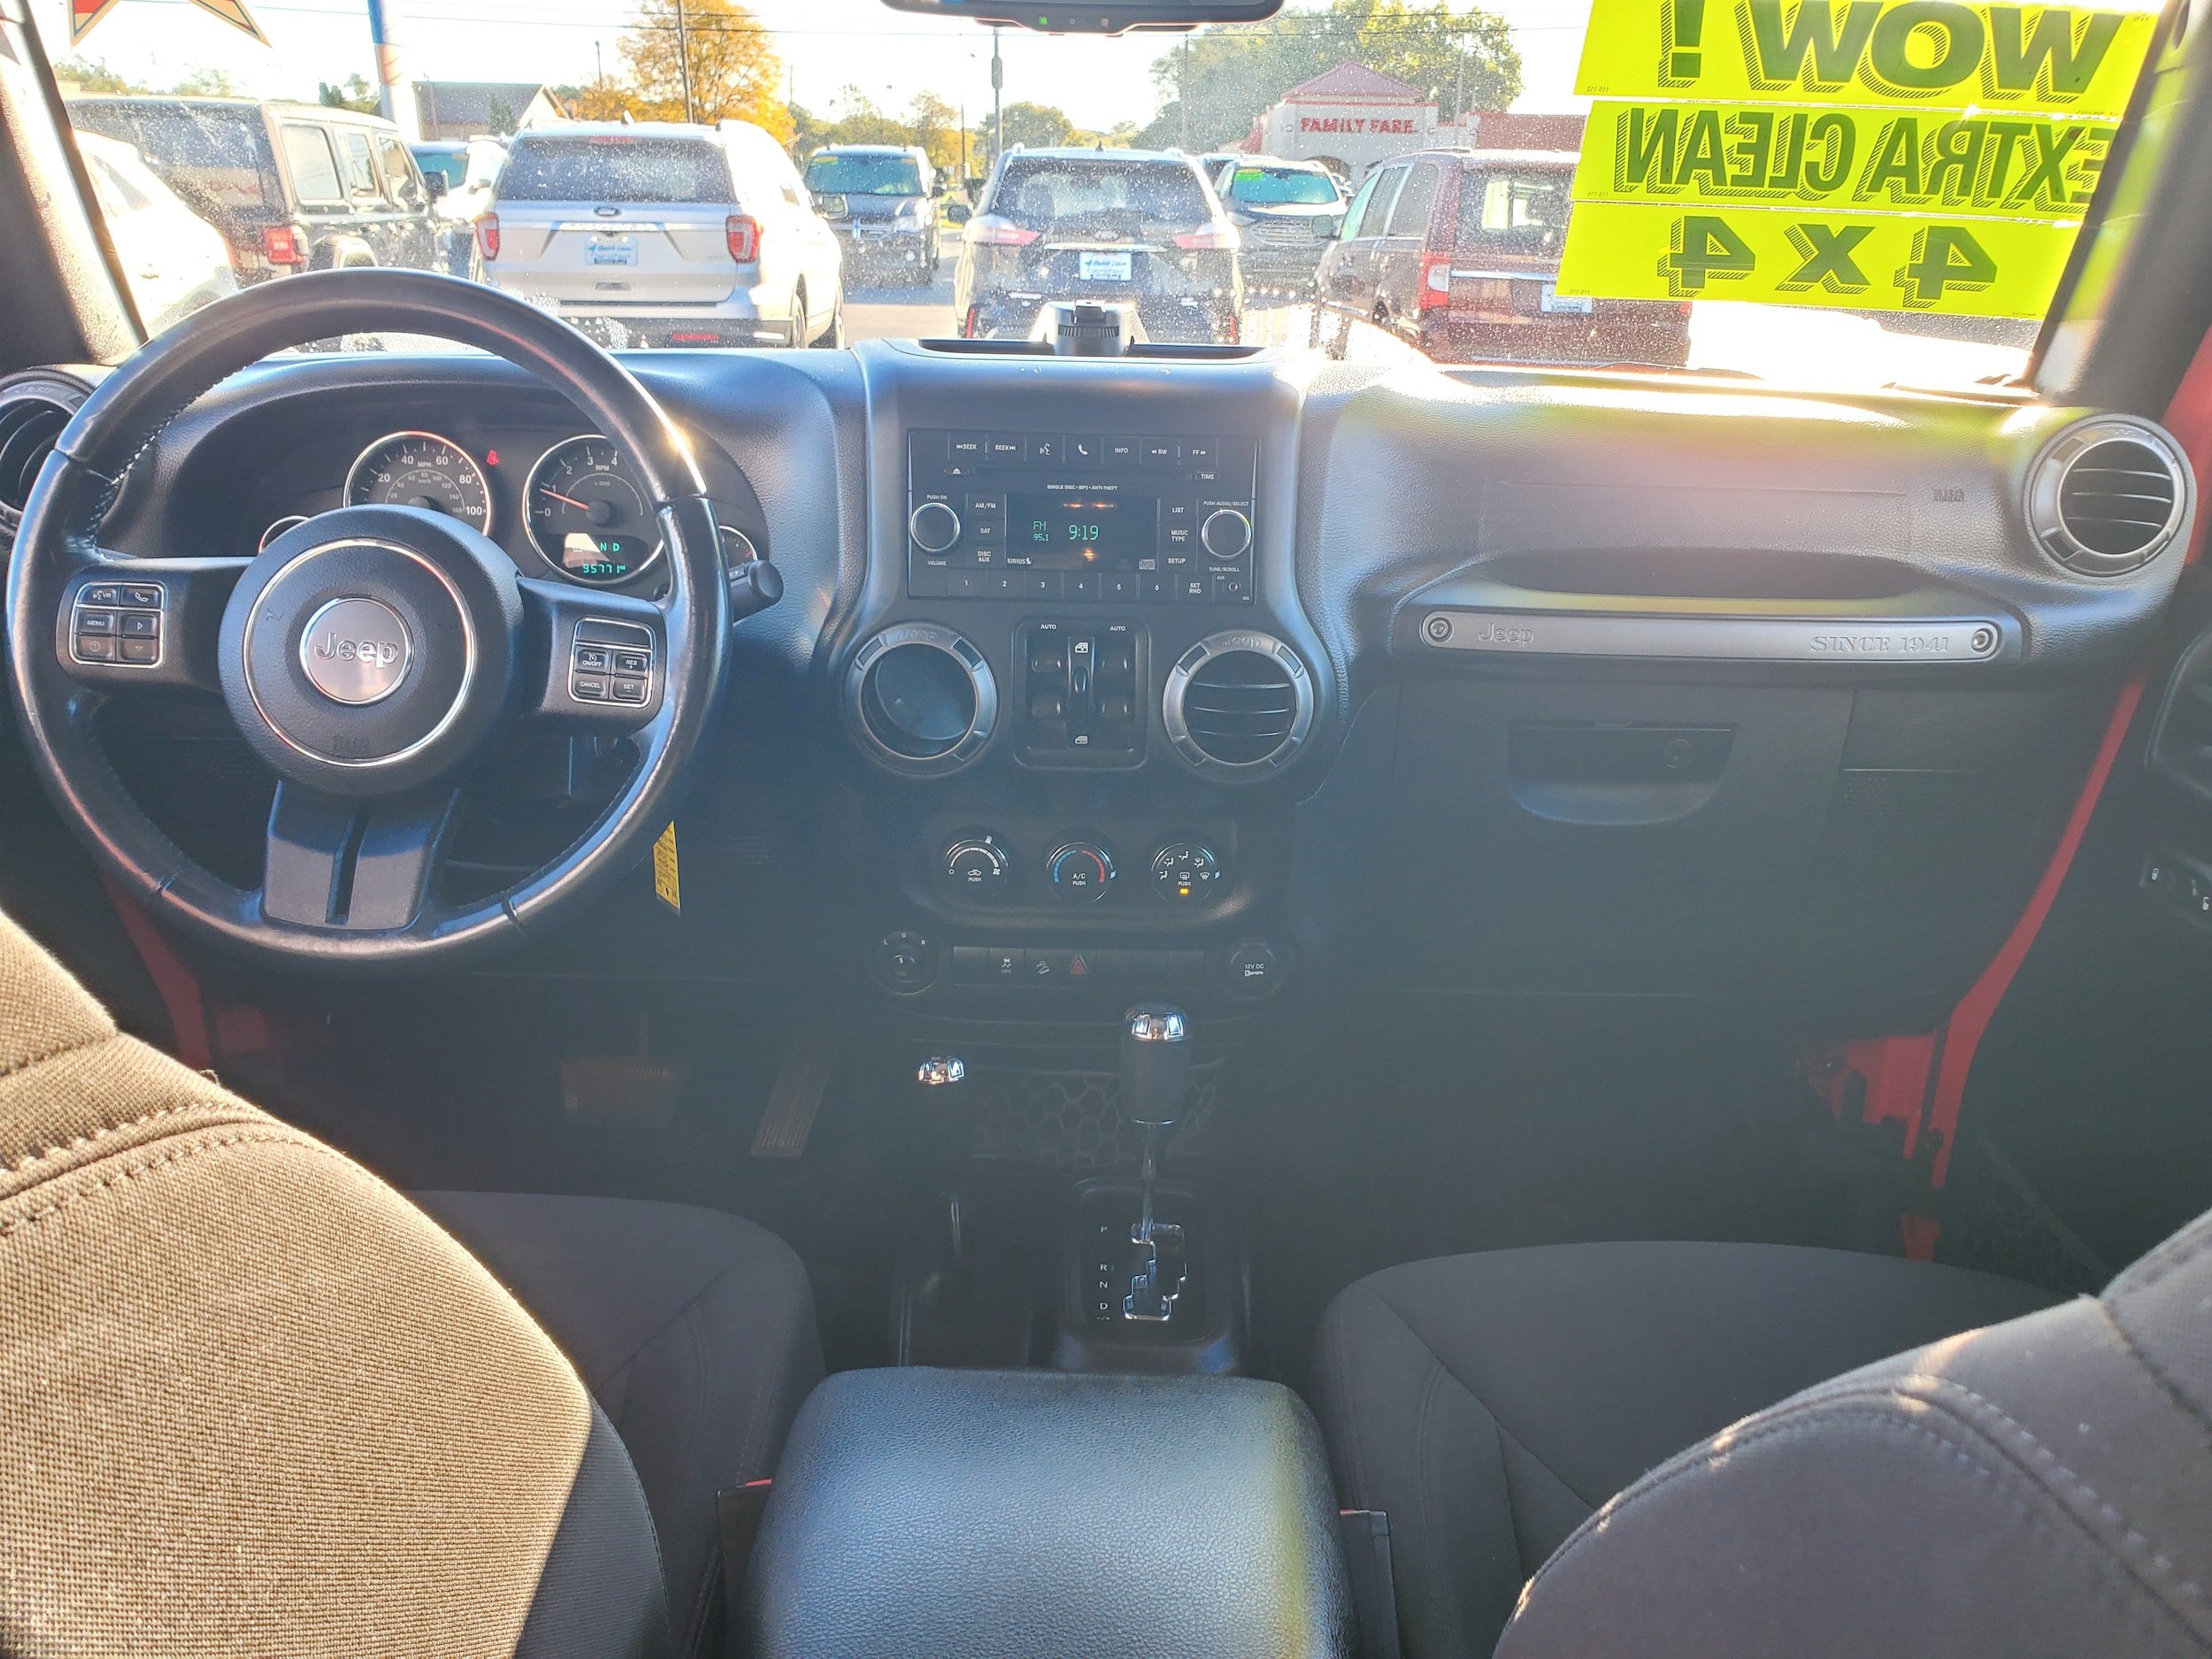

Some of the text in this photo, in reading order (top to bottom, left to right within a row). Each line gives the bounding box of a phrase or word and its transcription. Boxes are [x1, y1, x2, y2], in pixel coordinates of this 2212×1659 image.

[1301, 118, 1414, 134] FAMILY FARE
[401, 455, 414, 465] 40
[435, 456, 449, 465] 60
[587, 457, 594, 465] 3
[611, 457, 618, 465] 4
[378, 472, 390, 482] 20
[459, 474, 472, 484] 80
[465, 506, 482, 516] 100
[1033, 521, 1046, 530] FM
[1068, 525, 1099, 541] 9:19
[600, 542, 619, 551] N D
[1479, 622, 1534, 648] Jeep
[1810, 636, 1949, 653] SINCE 1941
[313, 632, 398, 669] Jeep
